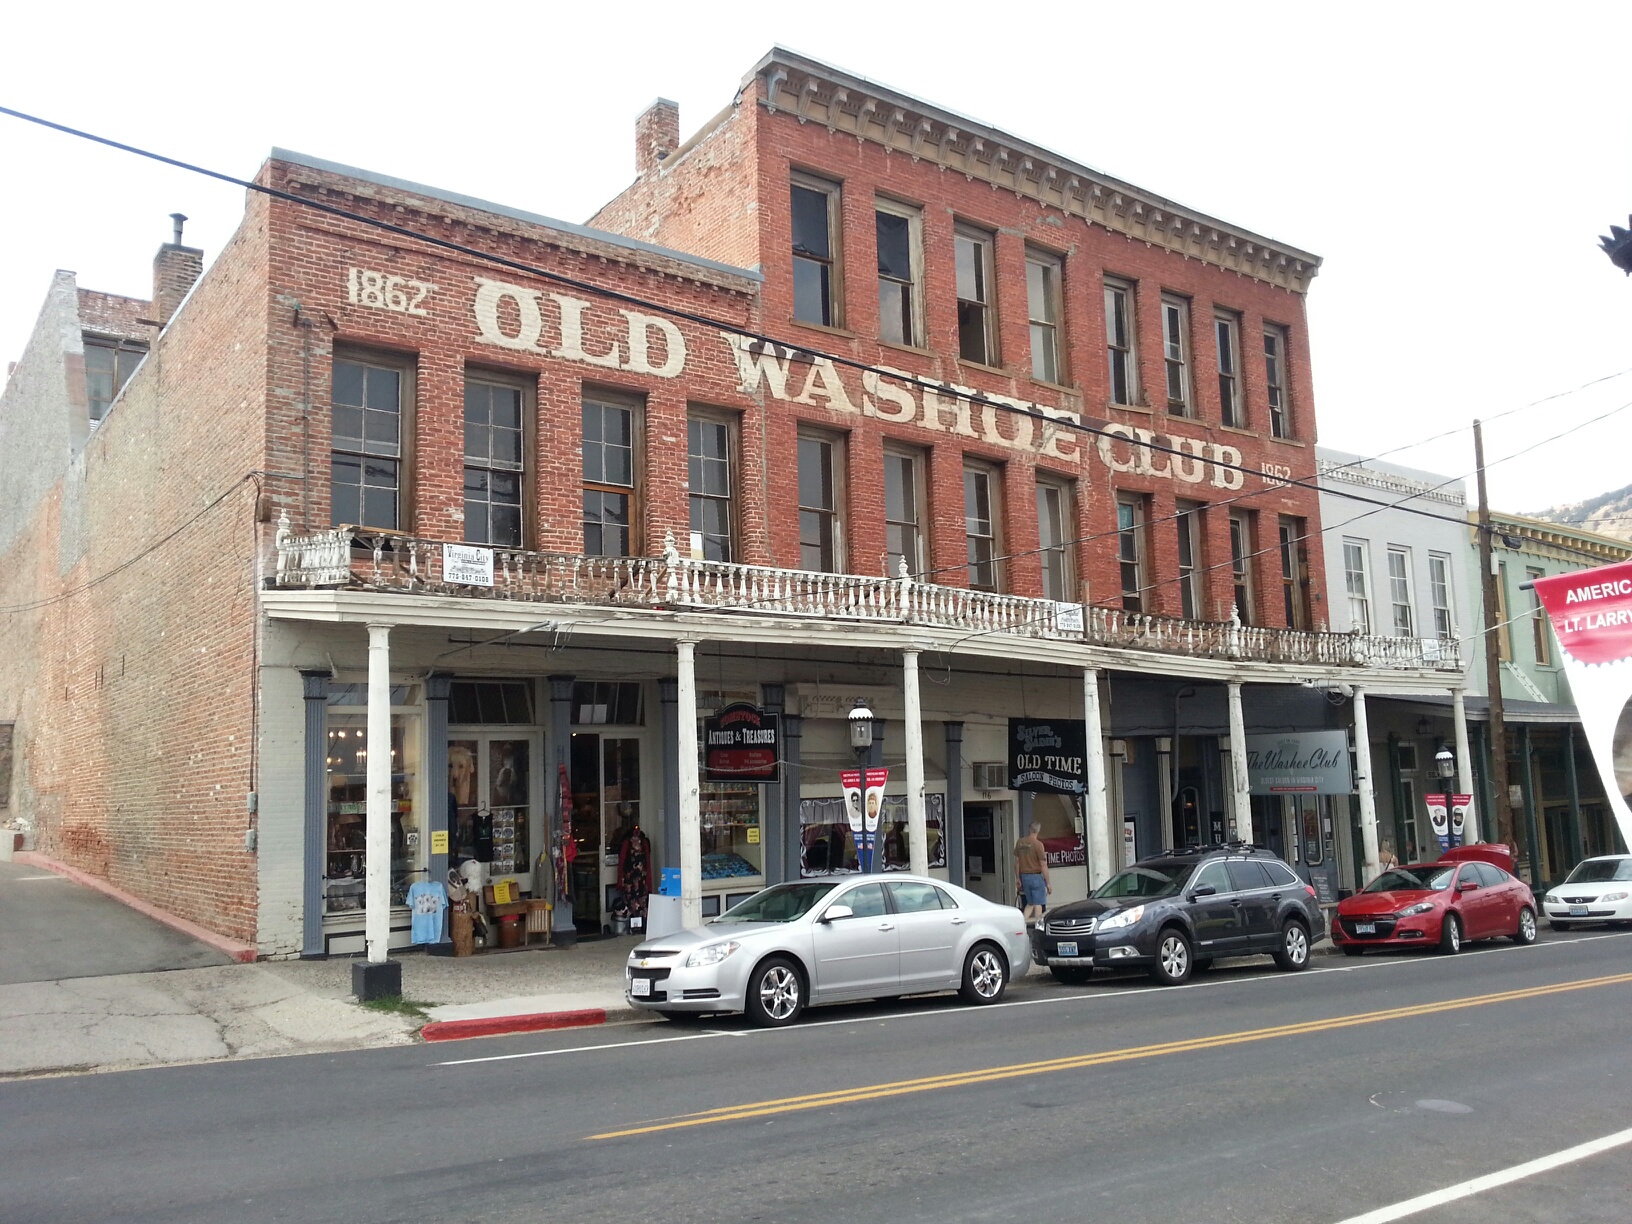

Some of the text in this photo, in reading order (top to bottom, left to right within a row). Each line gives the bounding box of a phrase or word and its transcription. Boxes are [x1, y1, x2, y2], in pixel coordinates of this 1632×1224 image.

[348, 267, 438, 316] 1862
[472, 275, 1244, 491] OLD WASHOE CLUB
[1261, 462, 1292, 488] 1862
[1564, 617, 1583, 633] LT.
[708, 727, 775, 745] ANTIQUES & TREASURES
[1016, 754, 1082, 775] OLD TIME
[1247, 747, 1341, 770] The Washoe Club
[1020, 772, 1074, 790] SALOON PHOTOS
[1061, 850, 1085, 863] PHOTOS
